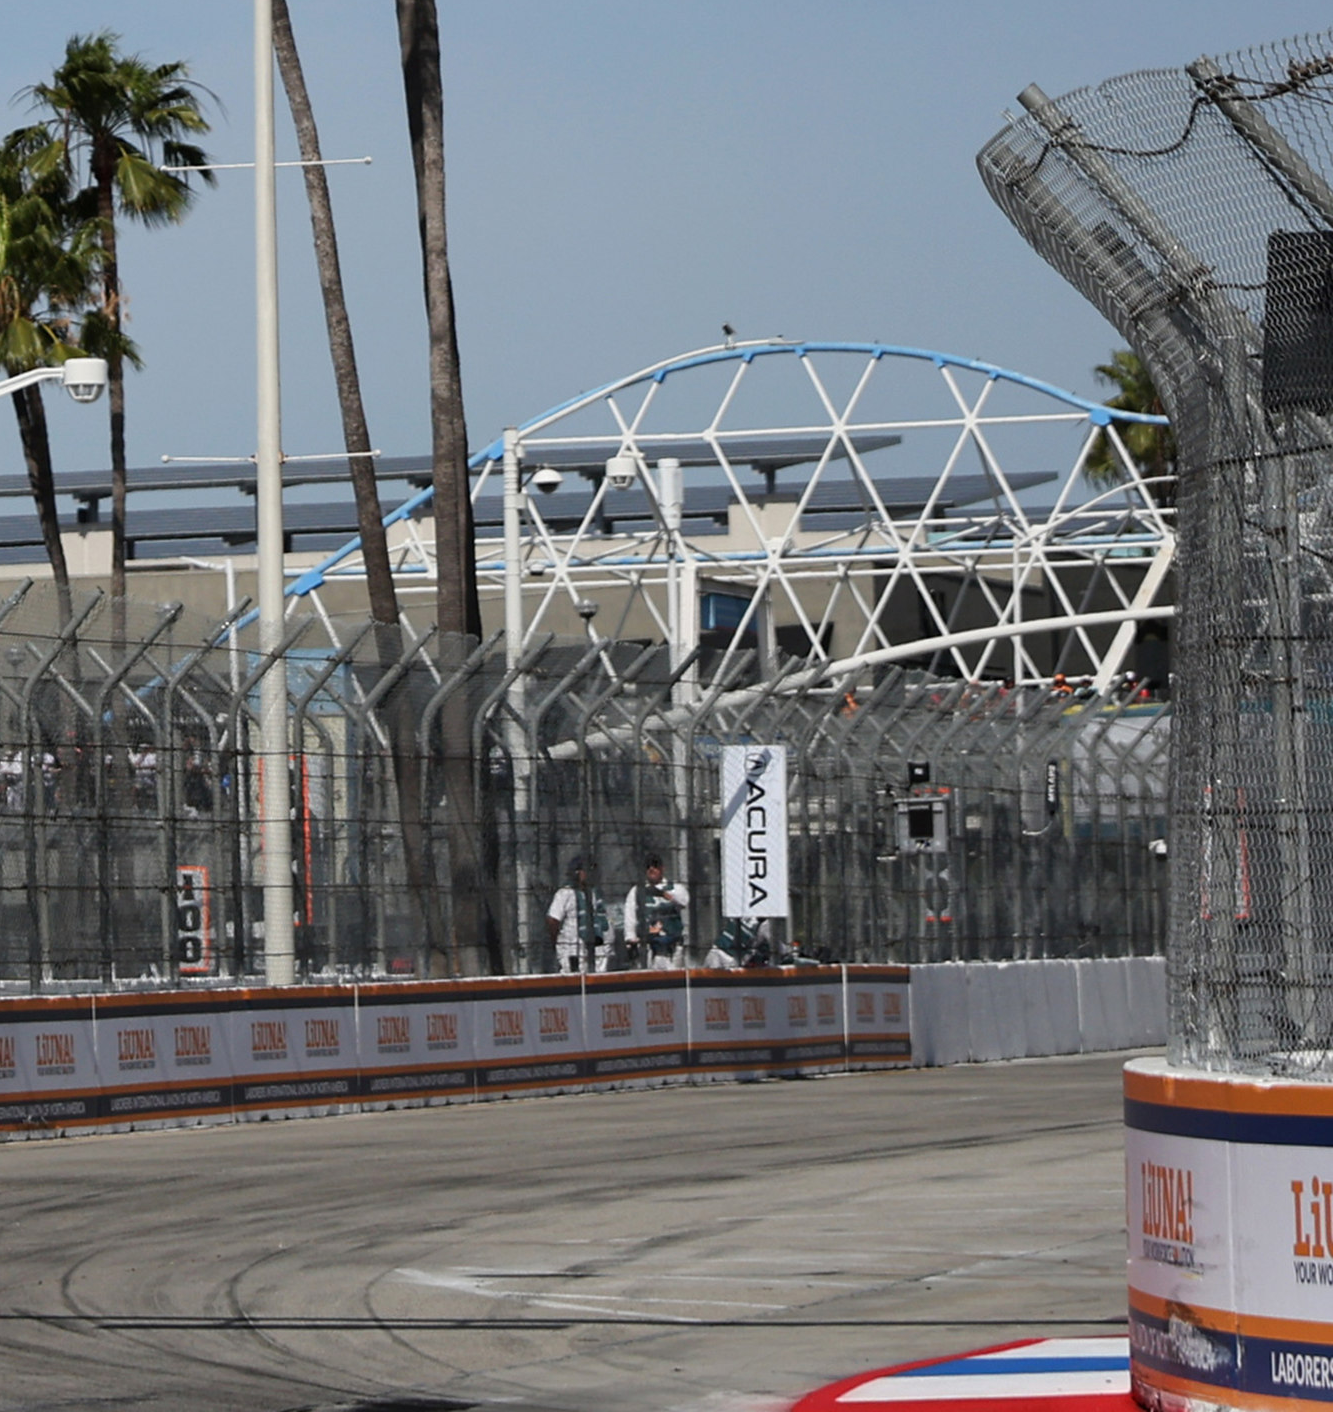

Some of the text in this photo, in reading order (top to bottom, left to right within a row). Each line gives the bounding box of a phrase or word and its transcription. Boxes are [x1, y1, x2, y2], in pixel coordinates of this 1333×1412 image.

[746, 779, 768, 908] ACURA
[178, 873, 201, 964] 100
[36, 1033, 75, 1067] LiUNA!
[1142, 1161, 1194, 1245] LiUNA!
[1294, 1261, 1317, 1285] YOUR
